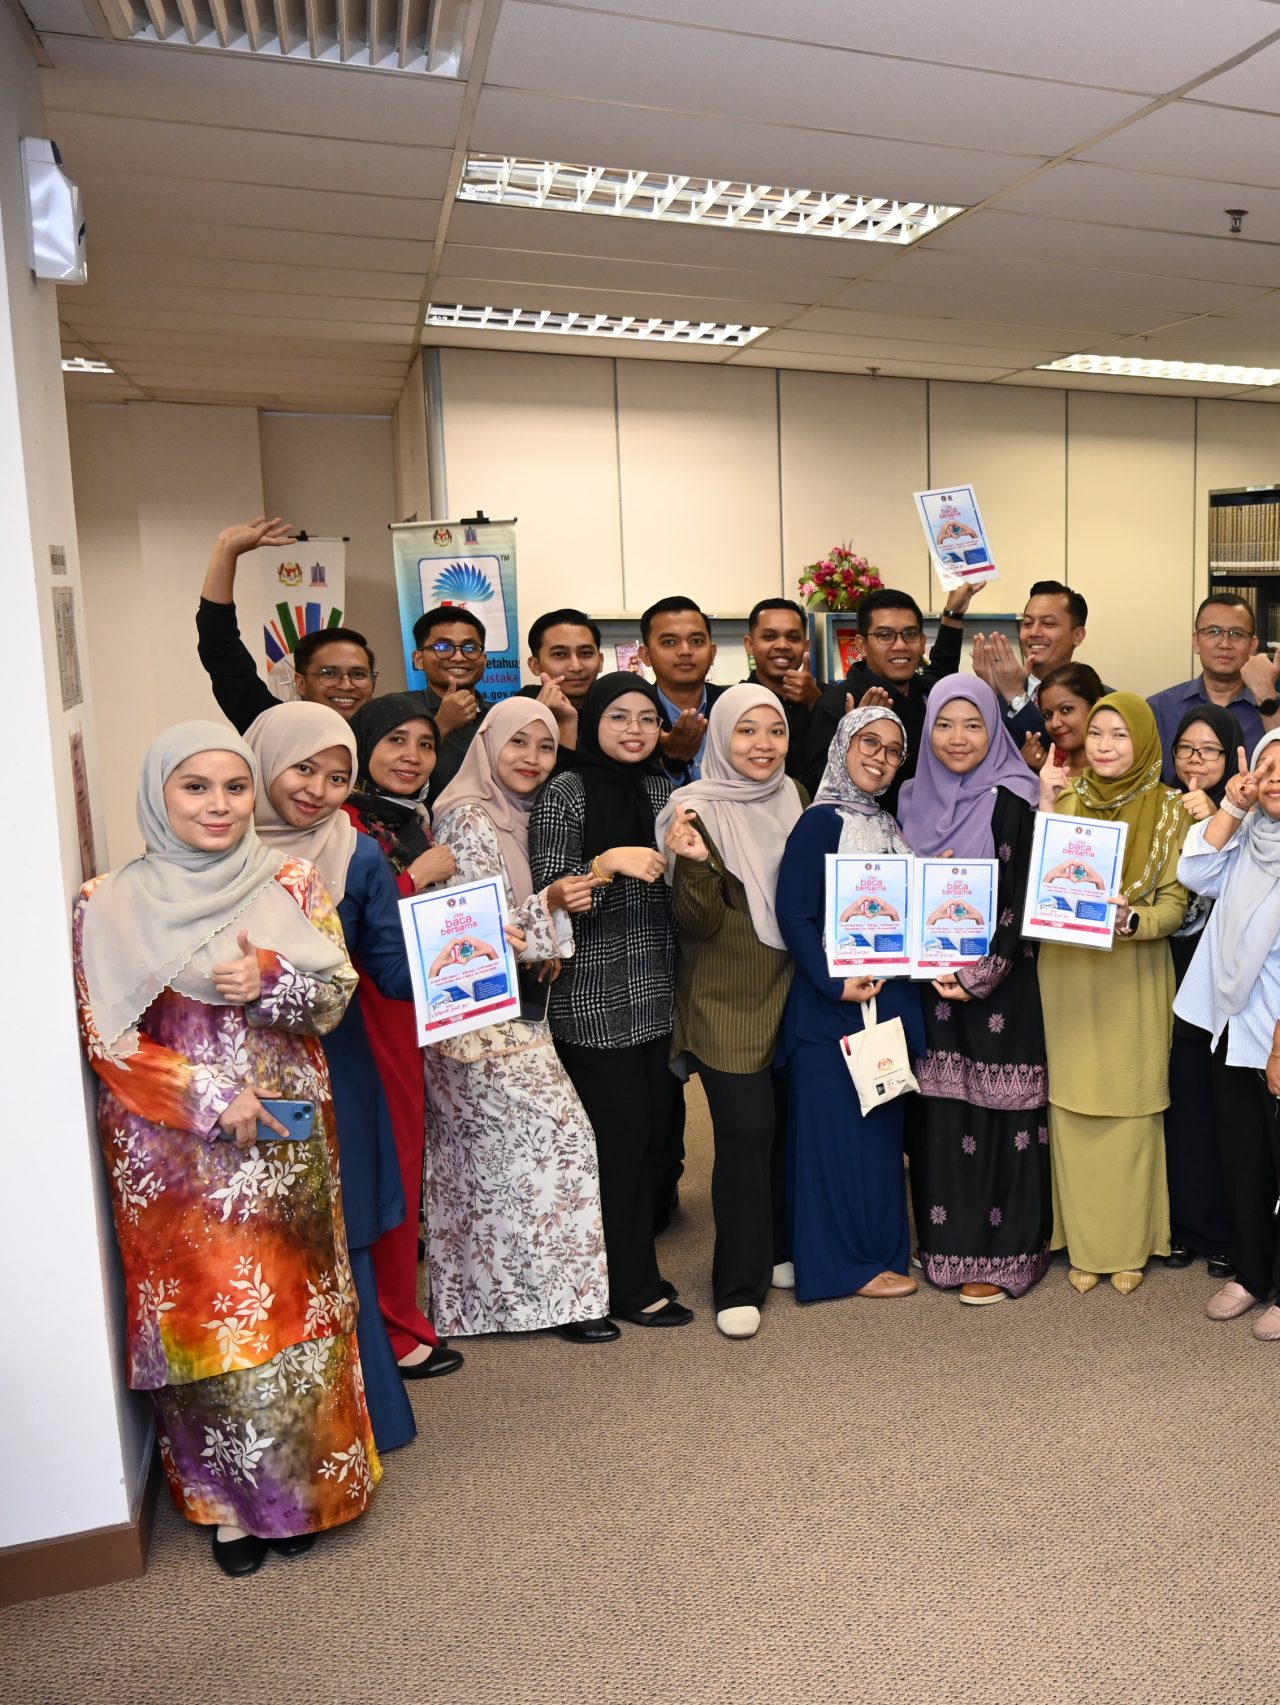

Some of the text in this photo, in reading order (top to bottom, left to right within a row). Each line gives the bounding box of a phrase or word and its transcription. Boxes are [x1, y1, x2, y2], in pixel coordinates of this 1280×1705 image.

[1068, 841, 1092, 851] baca
[1062, 848, 1095, 858] bersama
[860, 879, 883, 887] baca
[946, 883, 969, 891] baca
[445, 916, 472, 929] baca
[440, 922, 478, 936] bersama
